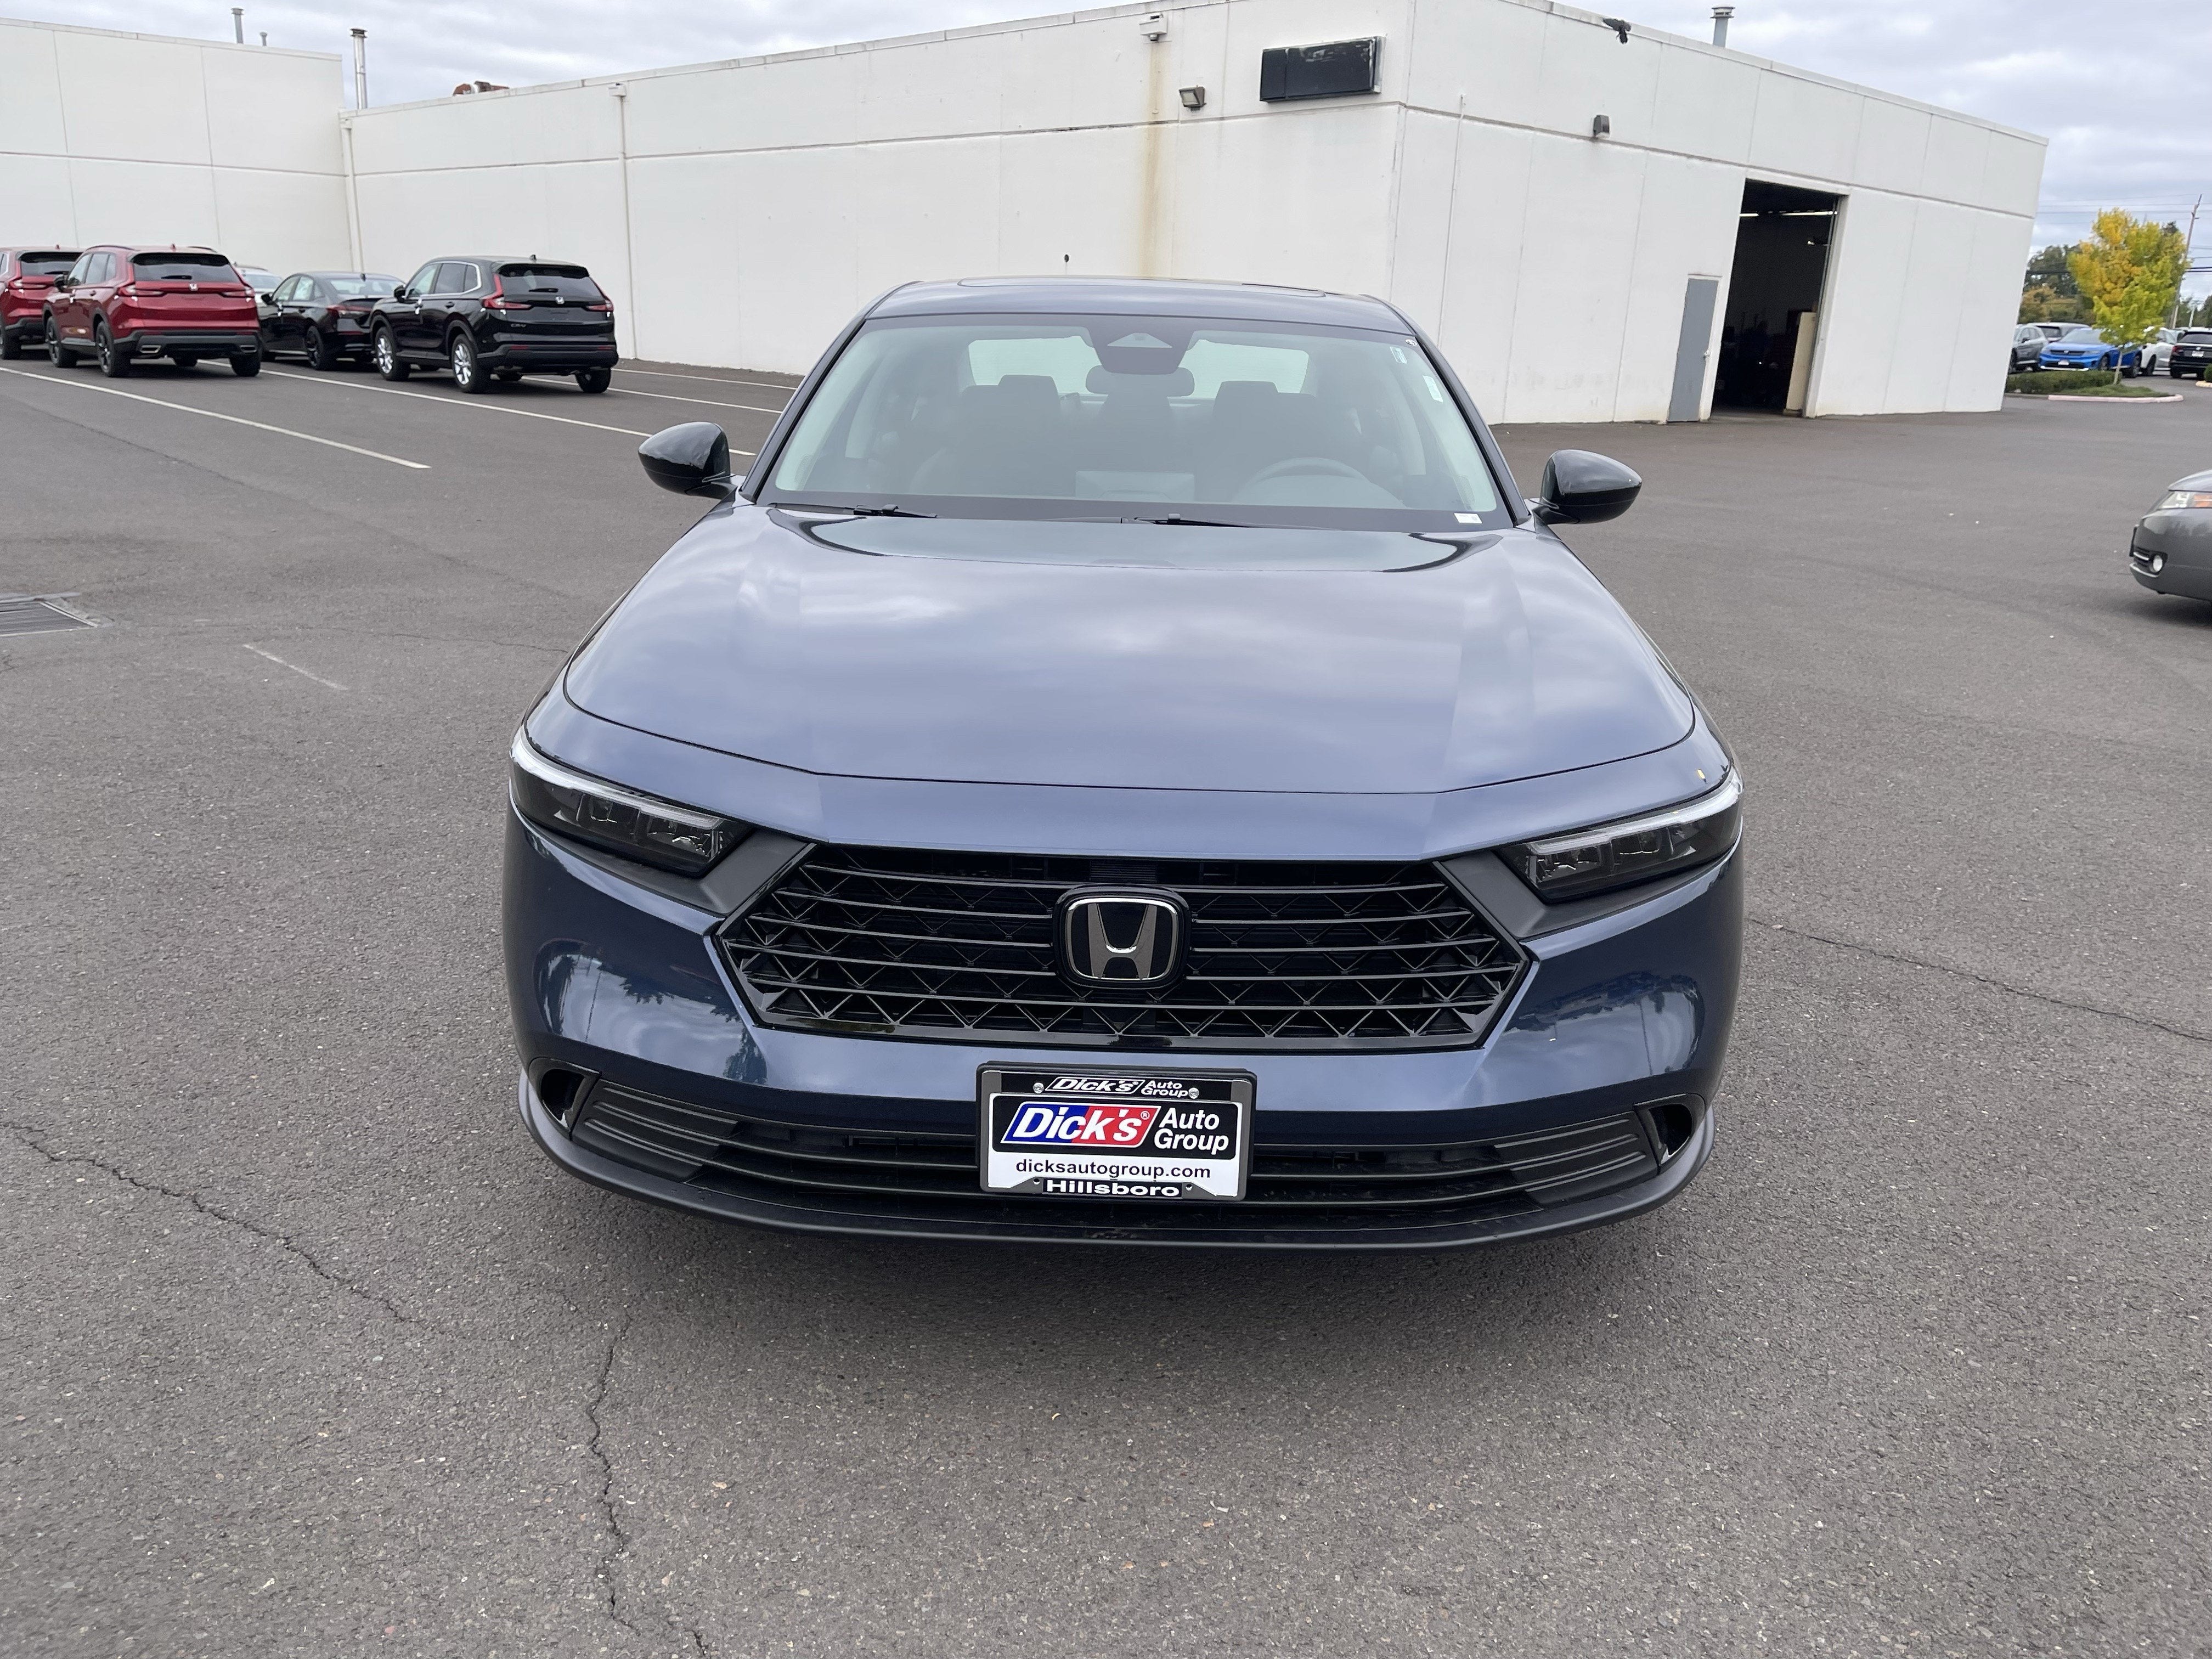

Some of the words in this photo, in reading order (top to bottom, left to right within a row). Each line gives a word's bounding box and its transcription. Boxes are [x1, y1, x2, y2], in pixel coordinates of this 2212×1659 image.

[1052, 1078, 1133, 1092] Dick's
[1141, 1088, 1188, 1097] Group
[1144, 1080, 1182, 1089] Auto
[1013, 1107, 1142, 1141] Dick's
[1159, 1107, 1220, 1130] Auto
[1154, 1128, 1229, 1155] Group
[1016, 1159, 1210, 1181] dicksautogroup.com
[1046, 1180, 1180, 1197] Hillsboro
